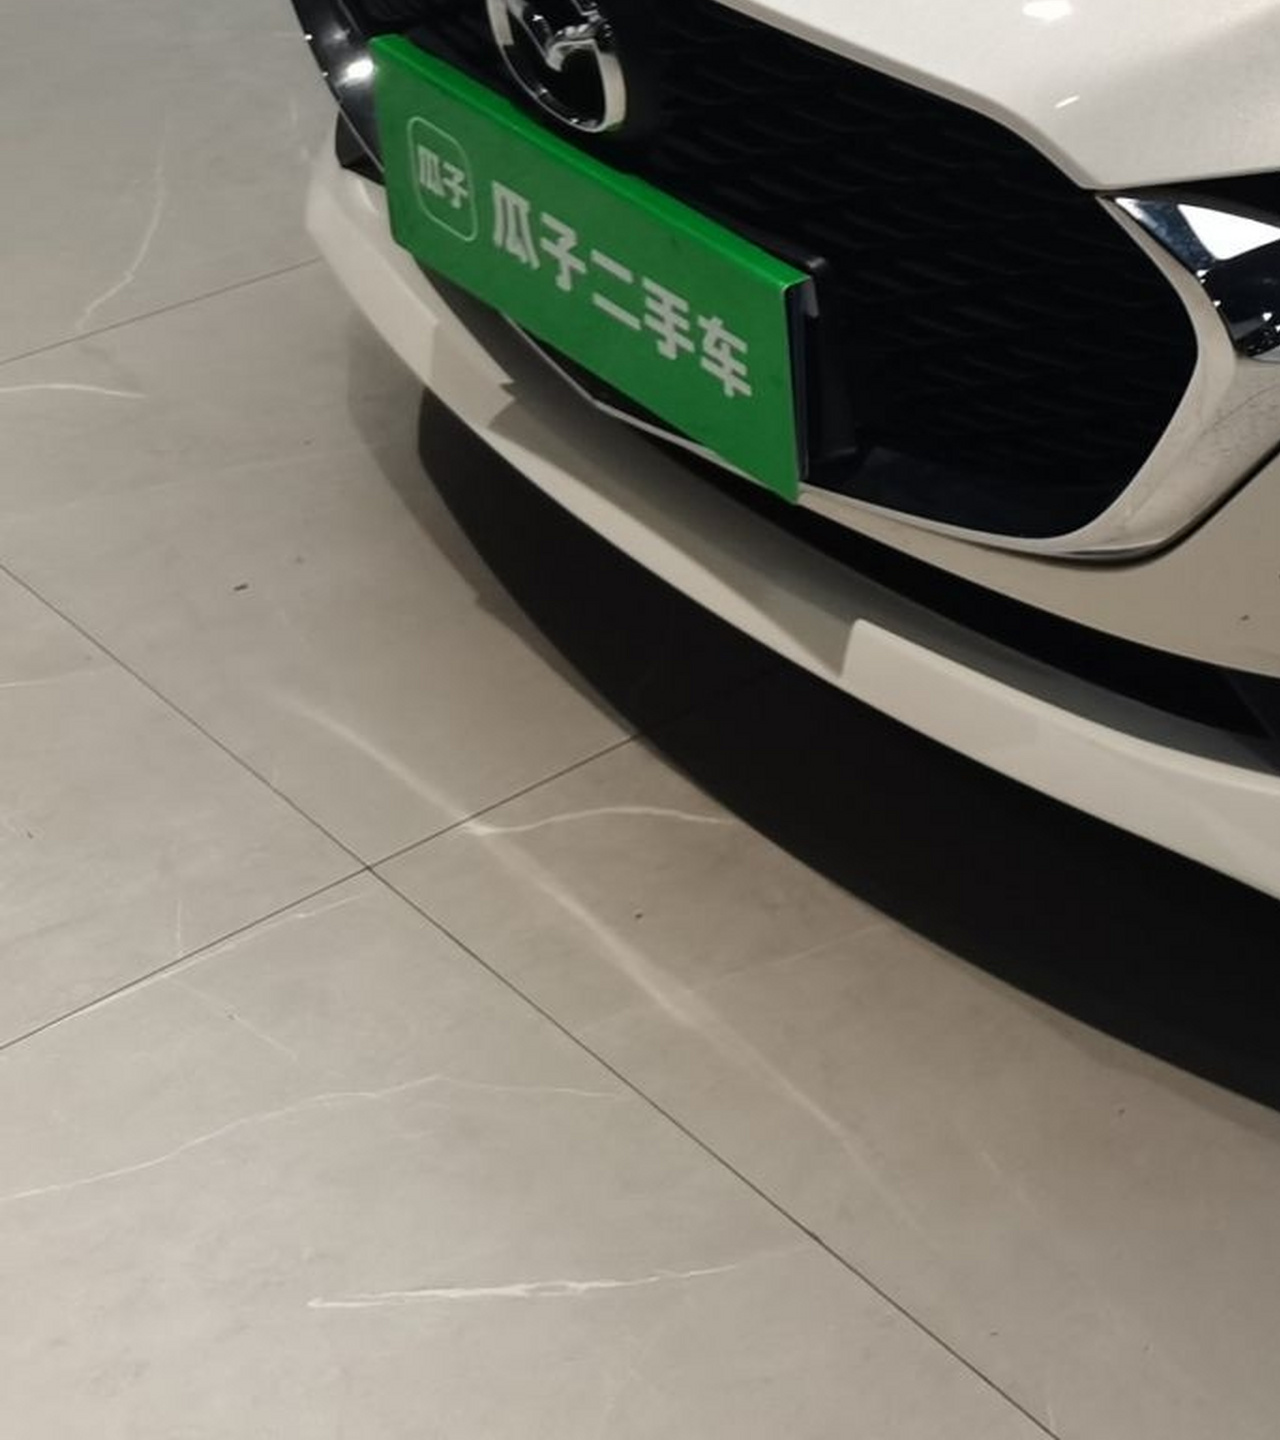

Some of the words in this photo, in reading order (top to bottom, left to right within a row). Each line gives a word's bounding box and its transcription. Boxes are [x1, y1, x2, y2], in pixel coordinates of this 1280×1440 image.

[417, 145, 468, 208] 瓜子
[492, 181, 752, 397] 瓜子二手车
